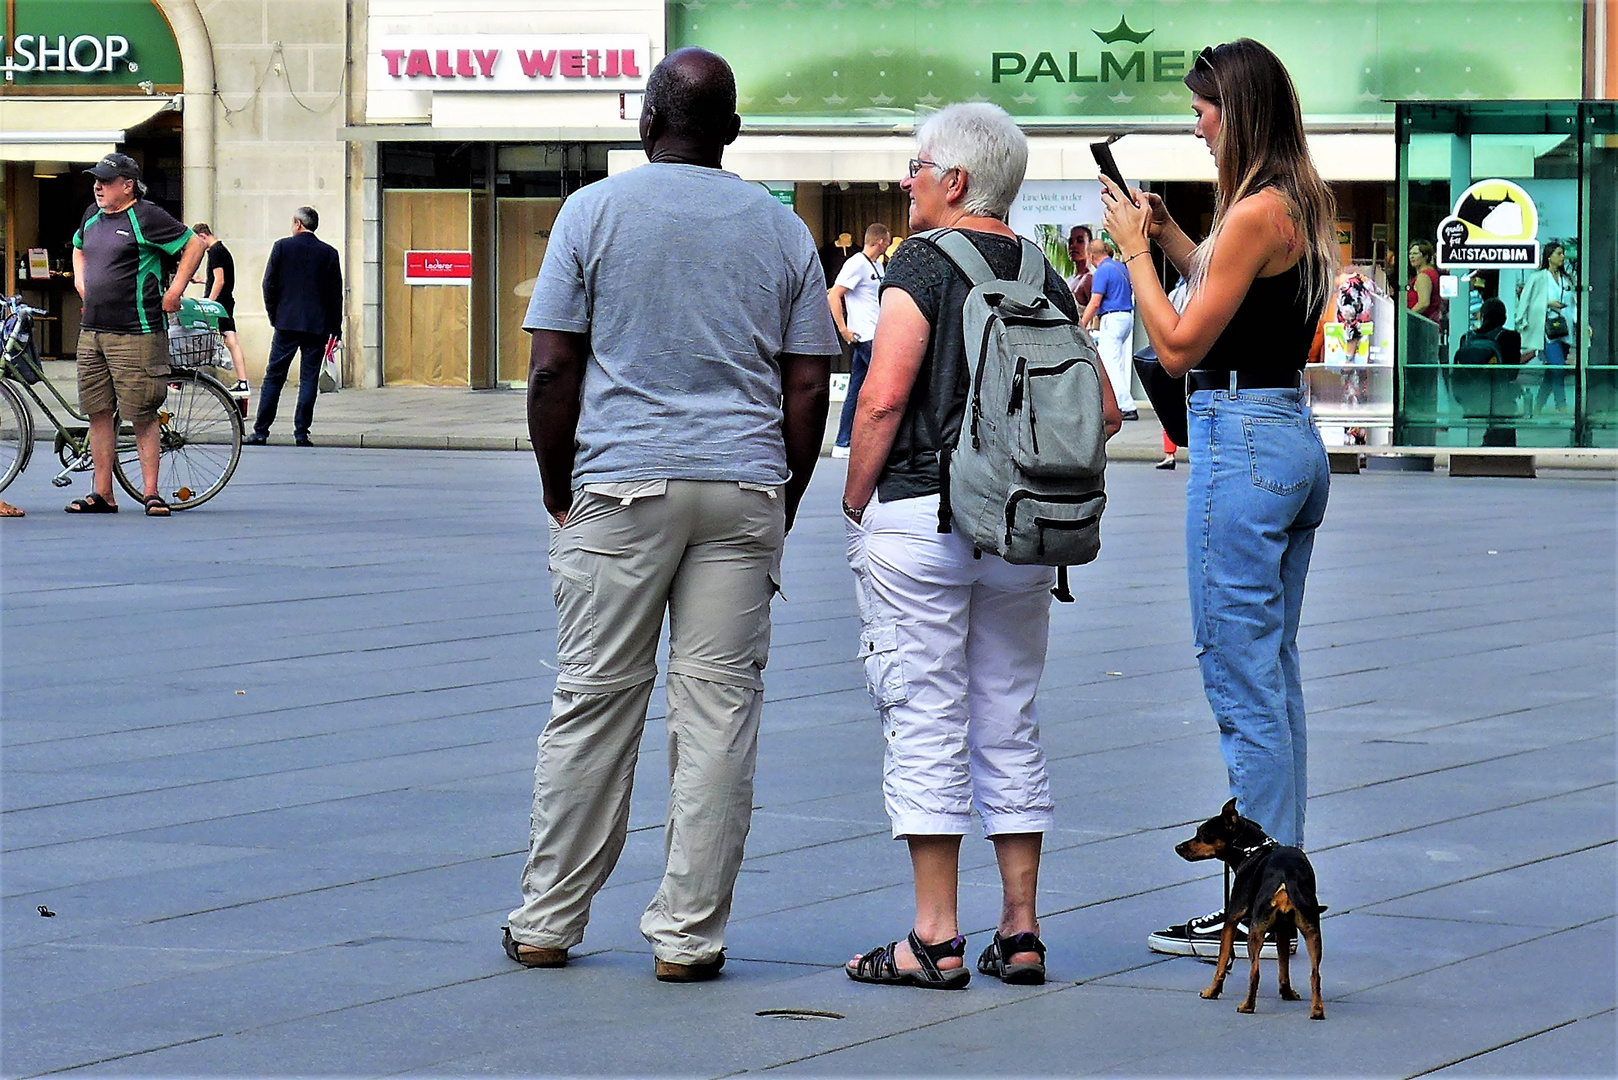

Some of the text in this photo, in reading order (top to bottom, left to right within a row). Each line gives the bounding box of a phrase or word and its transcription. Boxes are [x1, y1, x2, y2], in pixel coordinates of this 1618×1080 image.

[13, 34, 129, 72] SHOP
[381, 49, 500, 78] TALLY
[991, 50, 1200, 83] PALME
[1449, 247, 1528, 261] ALTSTADTBIM
